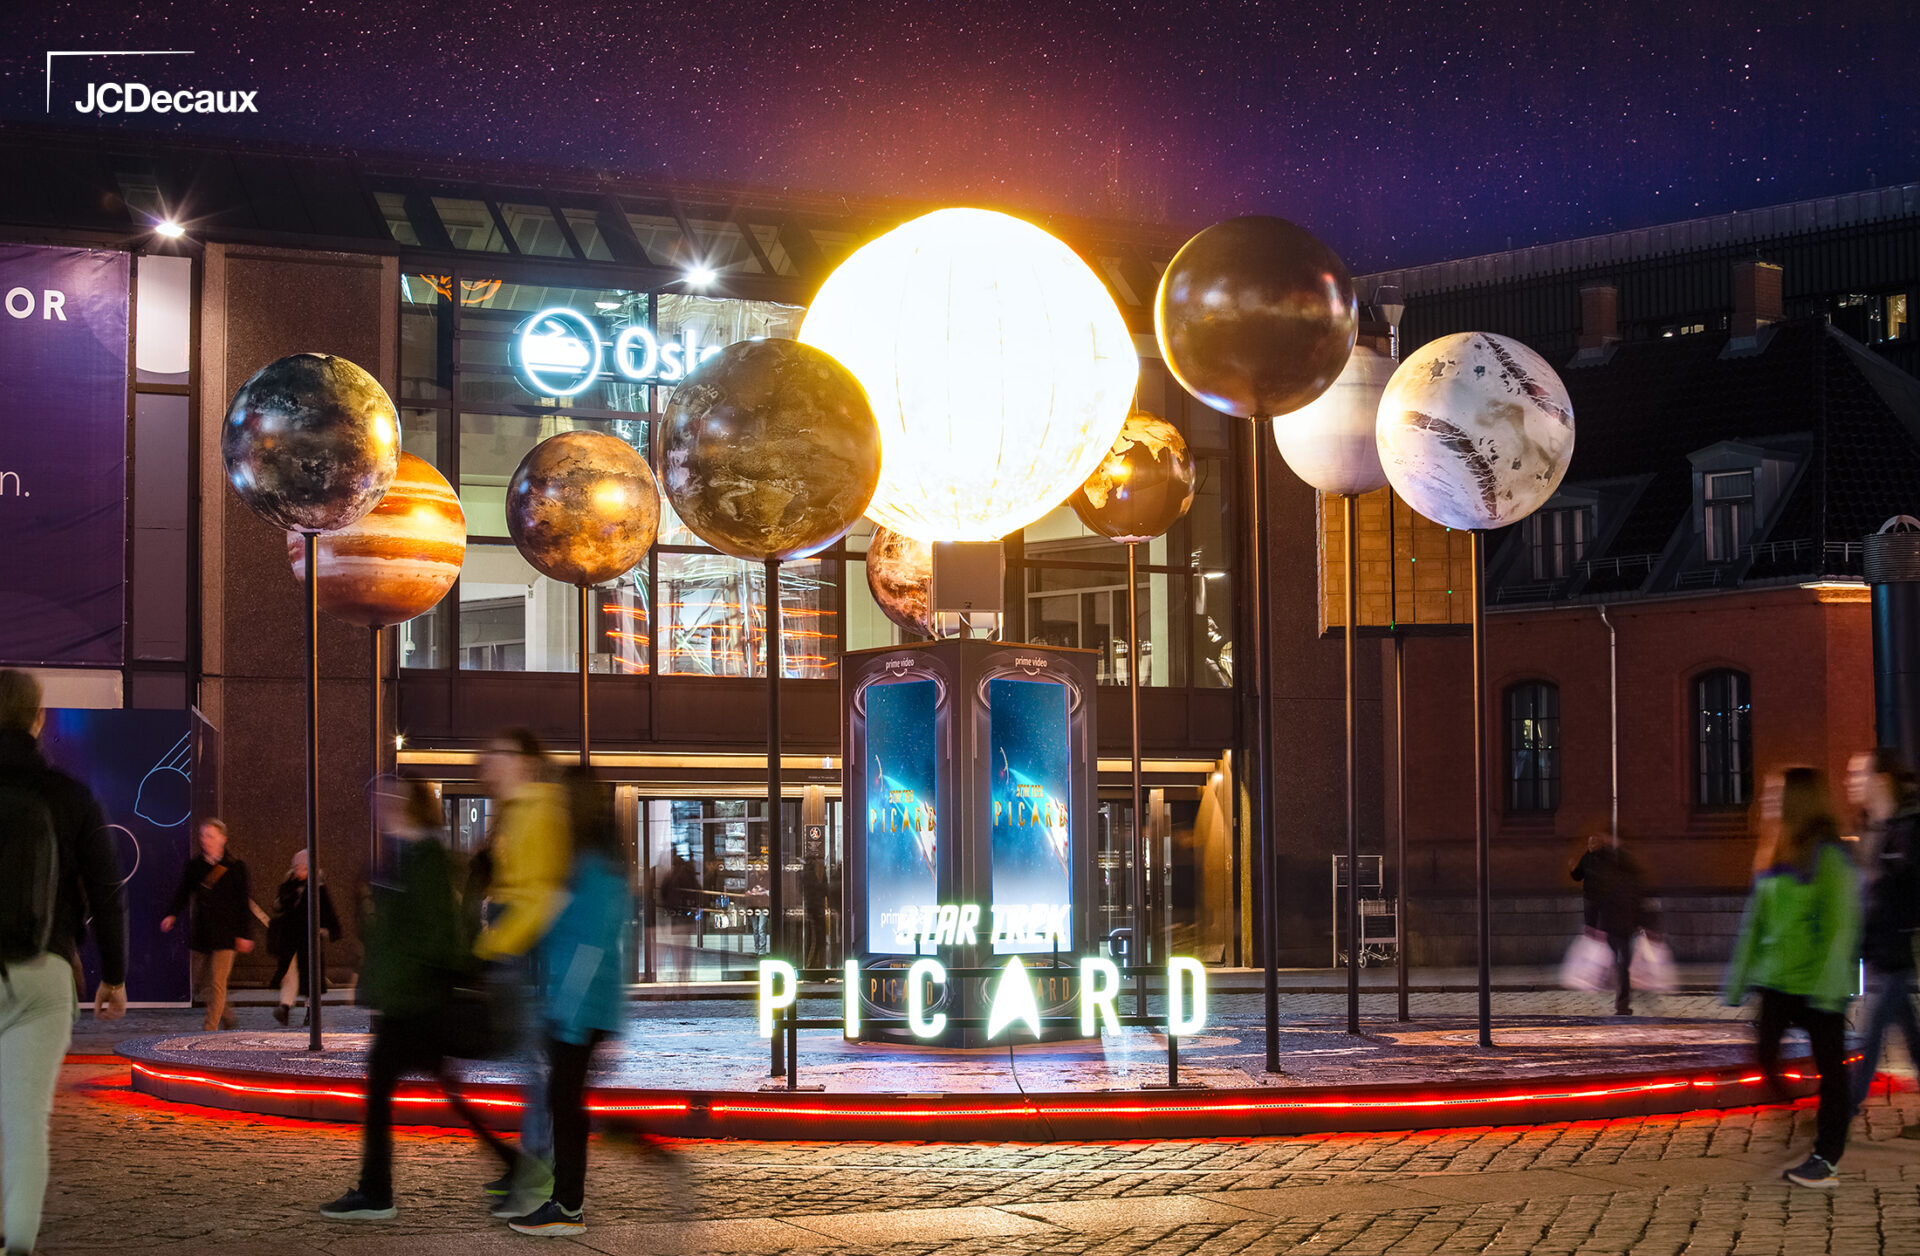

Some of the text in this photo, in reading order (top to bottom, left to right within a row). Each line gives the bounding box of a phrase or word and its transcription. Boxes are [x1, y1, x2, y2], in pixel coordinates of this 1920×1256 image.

[616, 326, 723, 381] Osl
[885, 657, 915, 671] prime video
[1015, 656, 1048, 668] prime video
[870, 806, 934, 834] PICARD
[994, 801, 1066, 828] PICARD
[895, 903, 1071, 946] STAR TREK
[759, 954, 1207, 1041] PICARD
